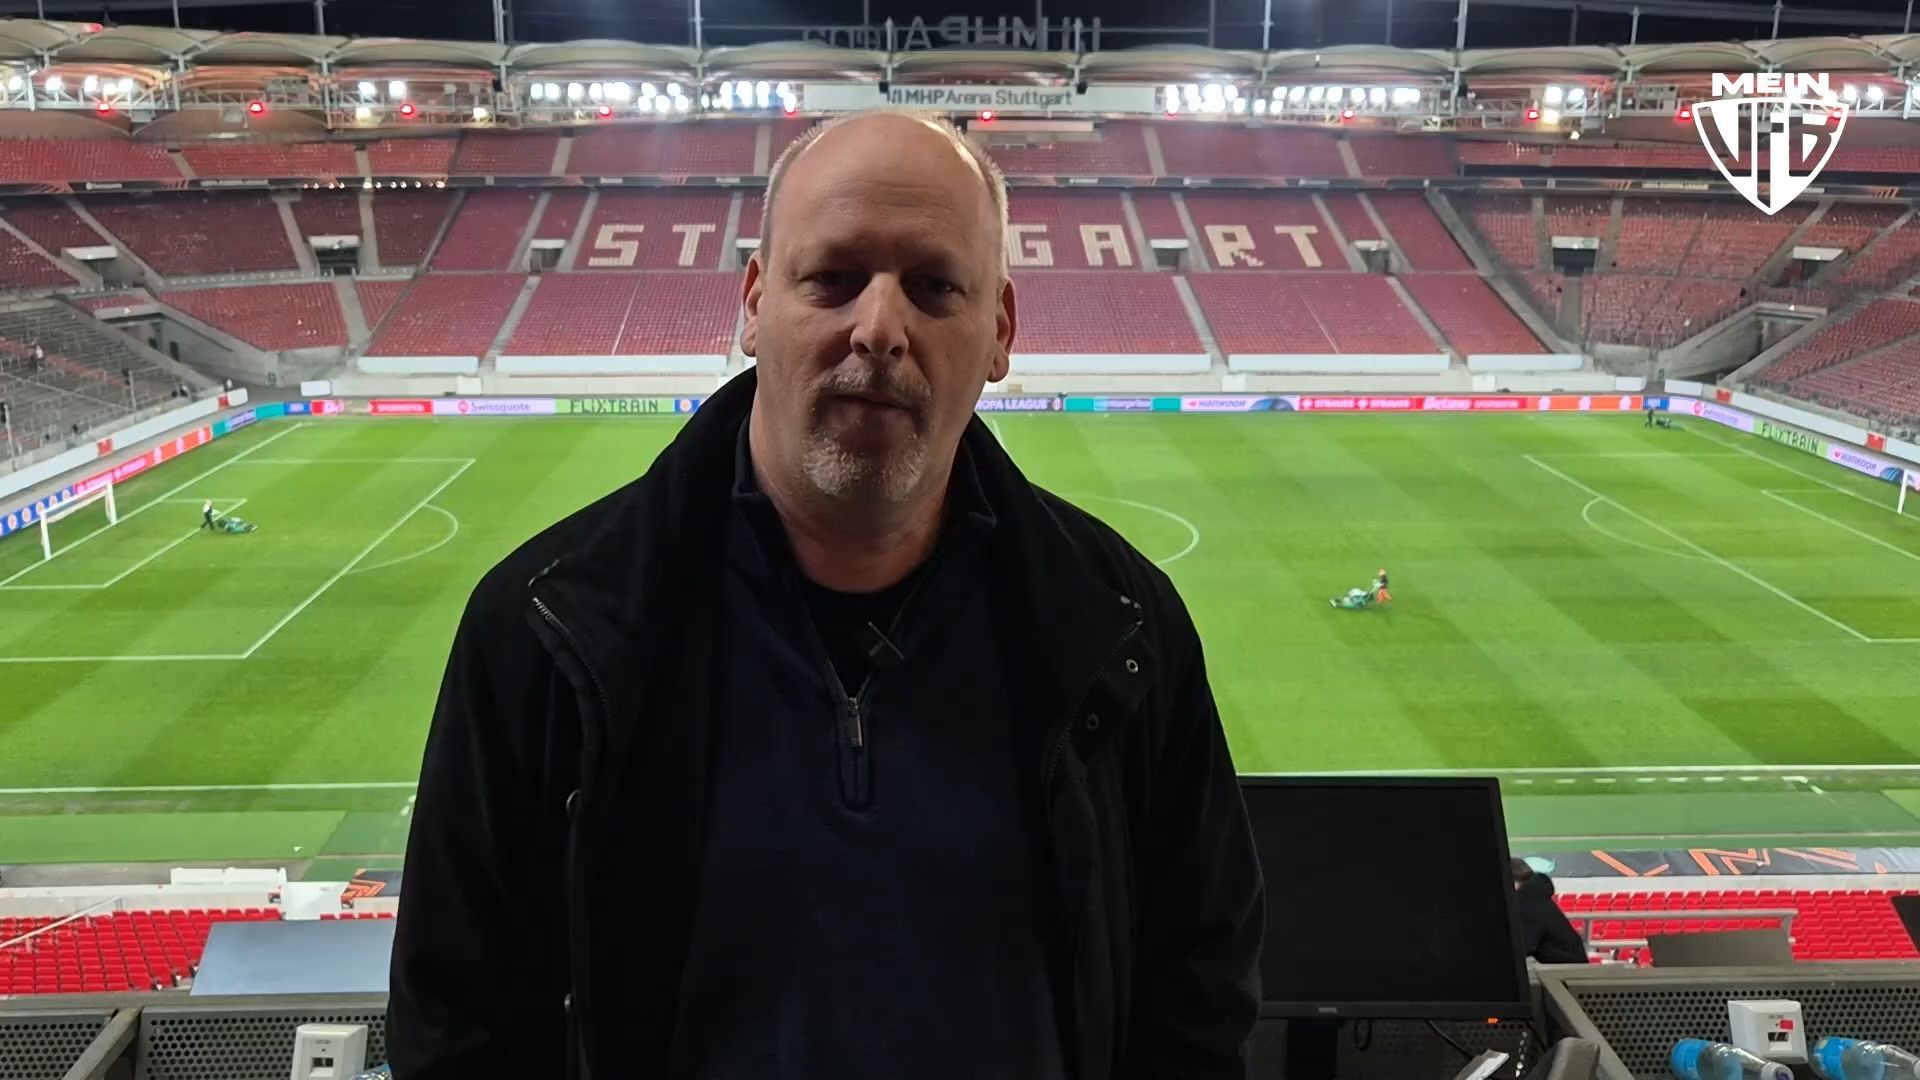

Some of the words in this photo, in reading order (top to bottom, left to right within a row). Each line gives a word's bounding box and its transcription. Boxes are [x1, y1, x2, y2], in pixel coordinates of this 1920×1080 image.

[905, 90, 946, 105] MHP
[946, 89, 992, 105] Arena
[995, 89, 1072, 109] Stuttgart
[471, 399, 531, 412] Swissquote
[570, 399, 658, 414] FLIXTRAIN
[1004, 398, 1048, 410] LEAGUE
[1761, 422, 1820, 455] FLIXTRAIN
